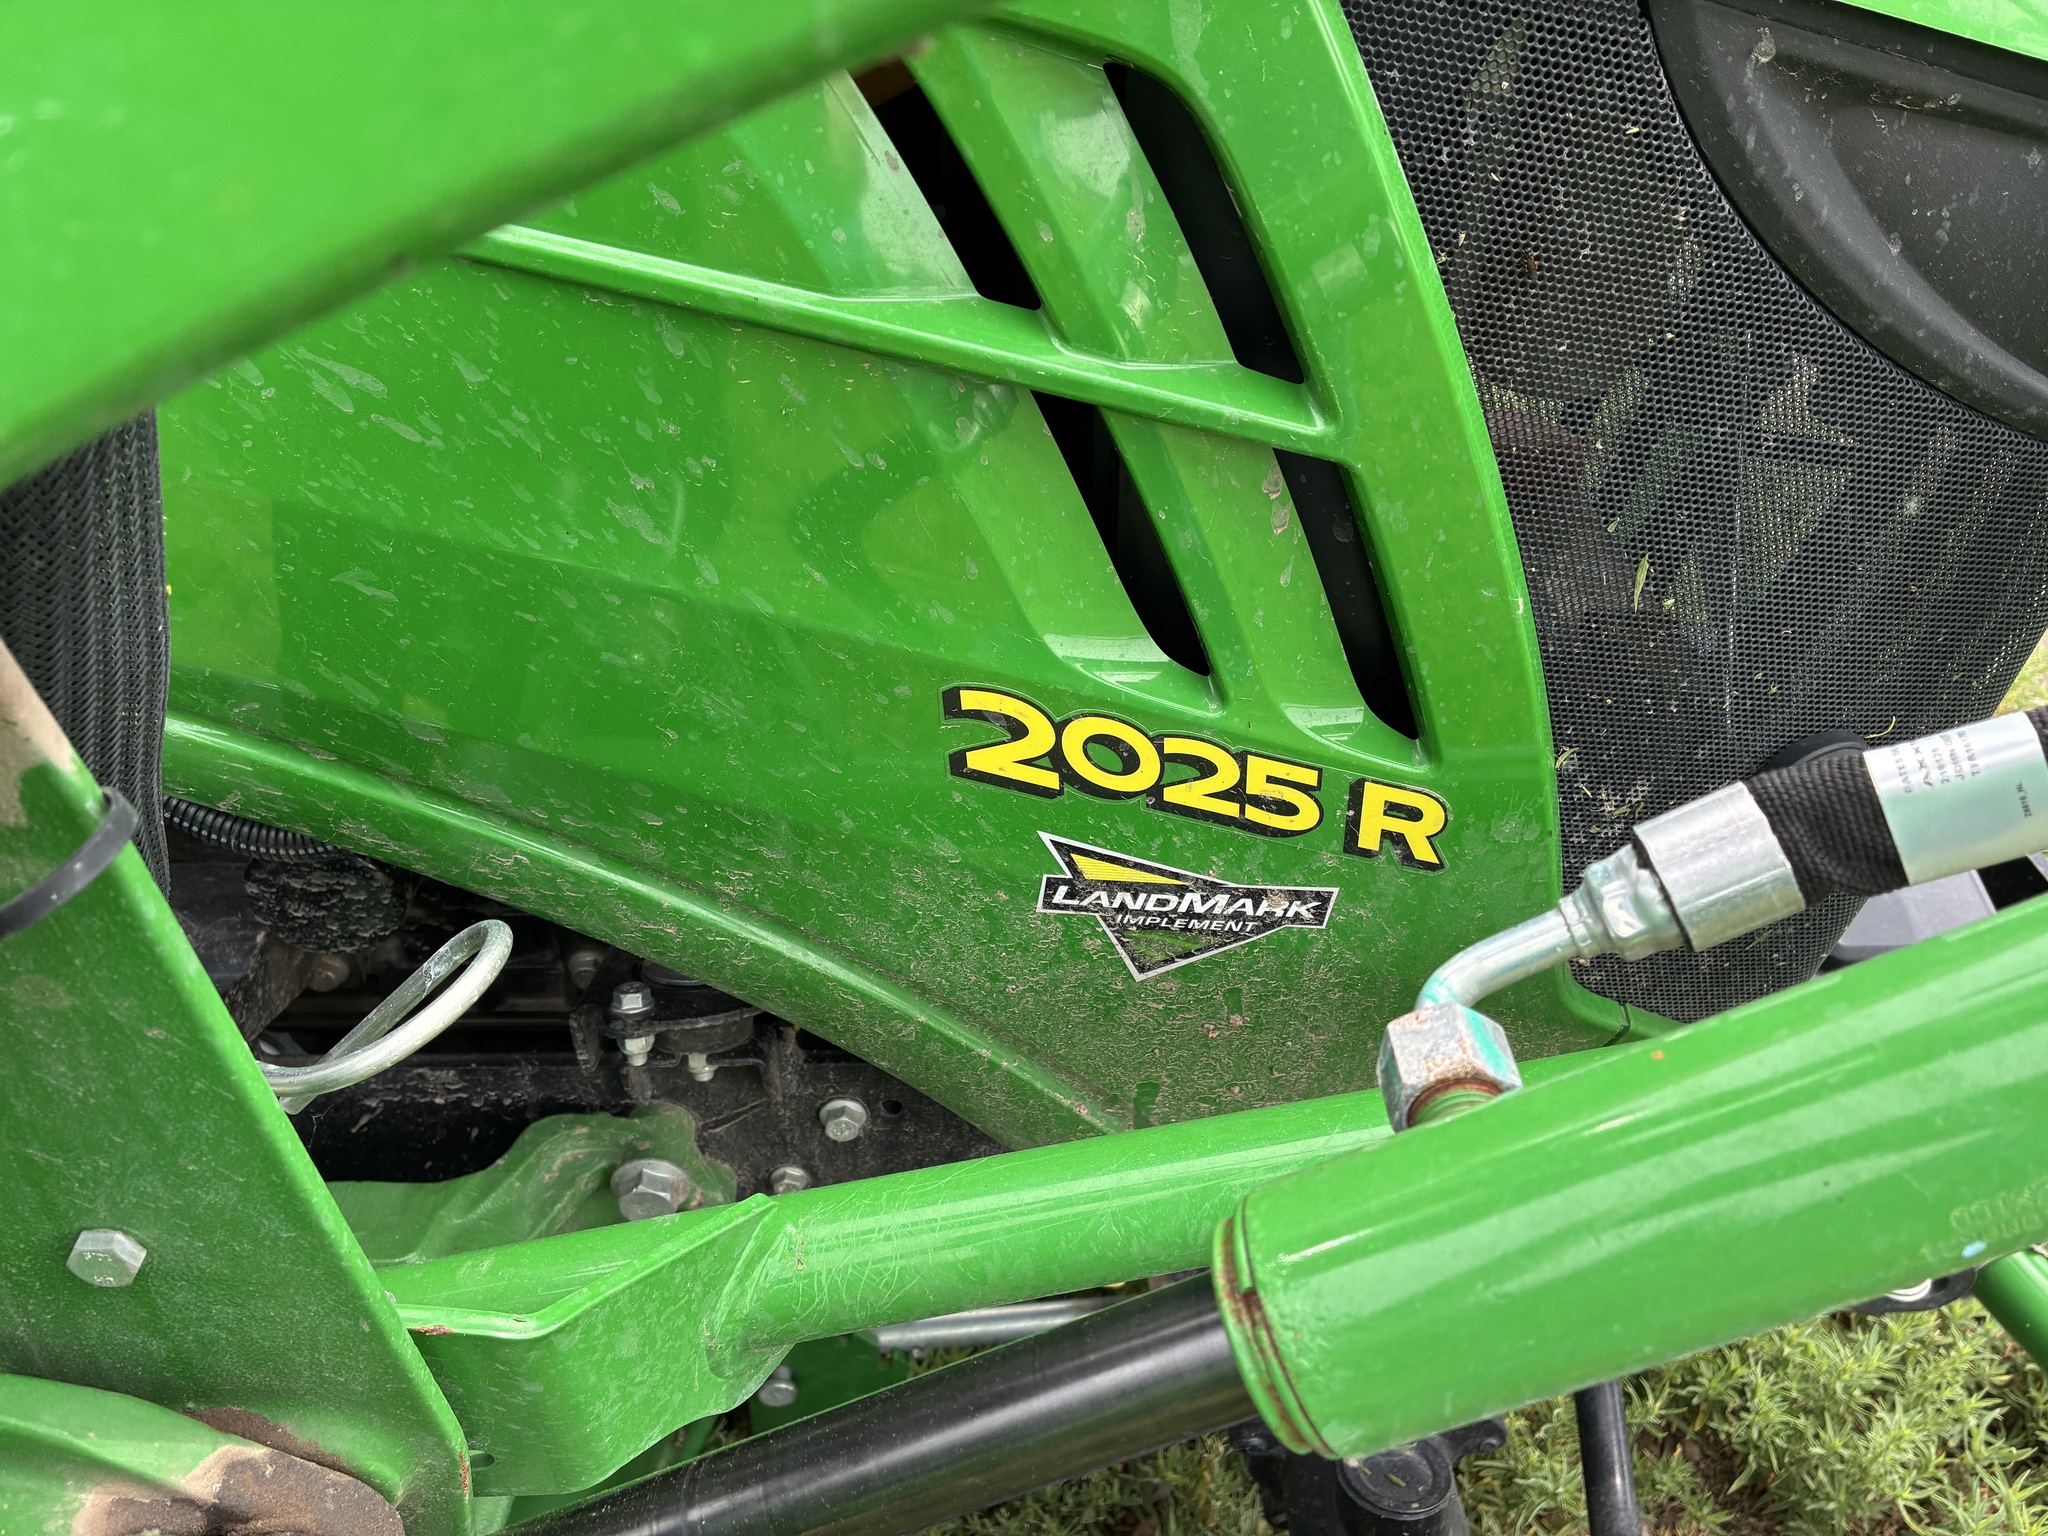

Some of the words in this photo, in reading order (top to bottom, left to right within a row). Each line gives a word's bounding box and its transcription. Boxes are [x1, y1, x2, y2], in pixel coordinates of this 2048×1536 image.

[943, 687, 1323, 838] 2025
[1344, 779, 1448, 871] R
[1911, 743, 1934, 788] AXX
[1115, 914, 1259, 933] IMPLEMENT
